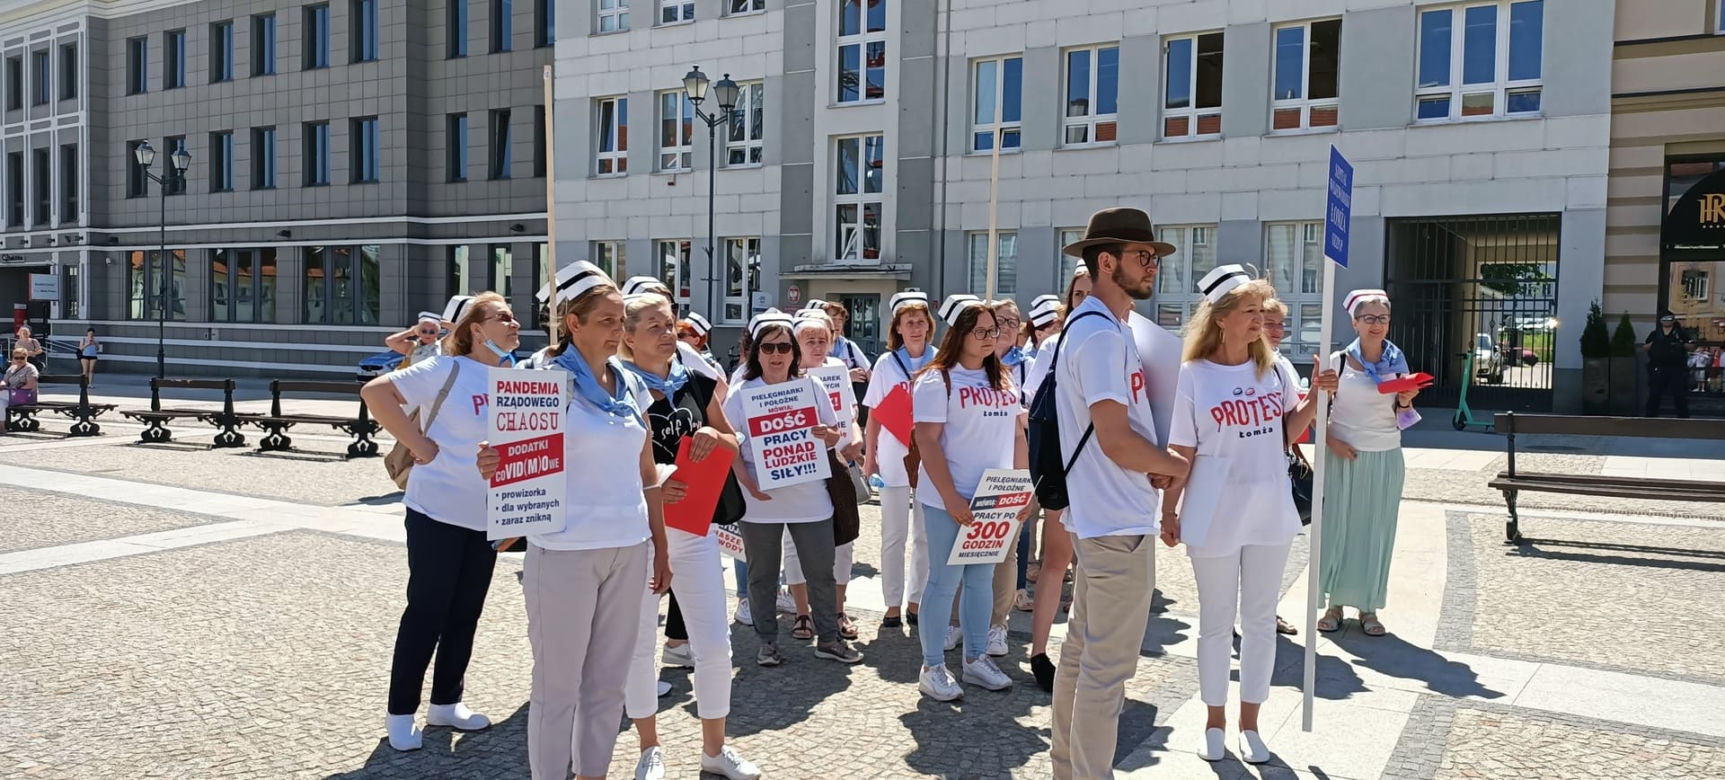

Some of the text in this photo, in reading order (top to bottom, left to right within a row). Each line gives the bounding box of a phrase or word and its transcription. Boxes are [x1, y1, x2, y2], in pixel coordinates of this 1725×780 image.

[496, 381, 559, 395] PANDEMIA
[751, 387, 804, 401] PIELĘGNIARKI
[496, 396, 560, 409] RZĄDOWEGO
[764, 395, 799, 407] POŁOŻNE
[496, 412, 559, 431] CHAOSU
[760, 410, 807, 433] DOŚĆ
[763, 430, 808, 447] PRACY
[508, 440, 549, 457] DODATKI
[763, 441, 815, 460] PONAD
[765, 452, 817, 469] LUDZKIE
[770, 463, 817, 481] SIŁY!!!
[986, 476, 1031, 484] PIELĘGNIARK
[501, 488, 546, 501] prowizorka
[998, 493, 1026, 505] DOŚĆ
[501, 498, 560, 512] dla wybranych
[501, 513, 552, 525] zaraz znikną
[974, 512, 1002, 520] PRACY
[966, 521, 1010, 540] 300
[962, 540, 1004, 550] GODZIN
[958, 550, 1000, 558] MIESIĘCZNIE
